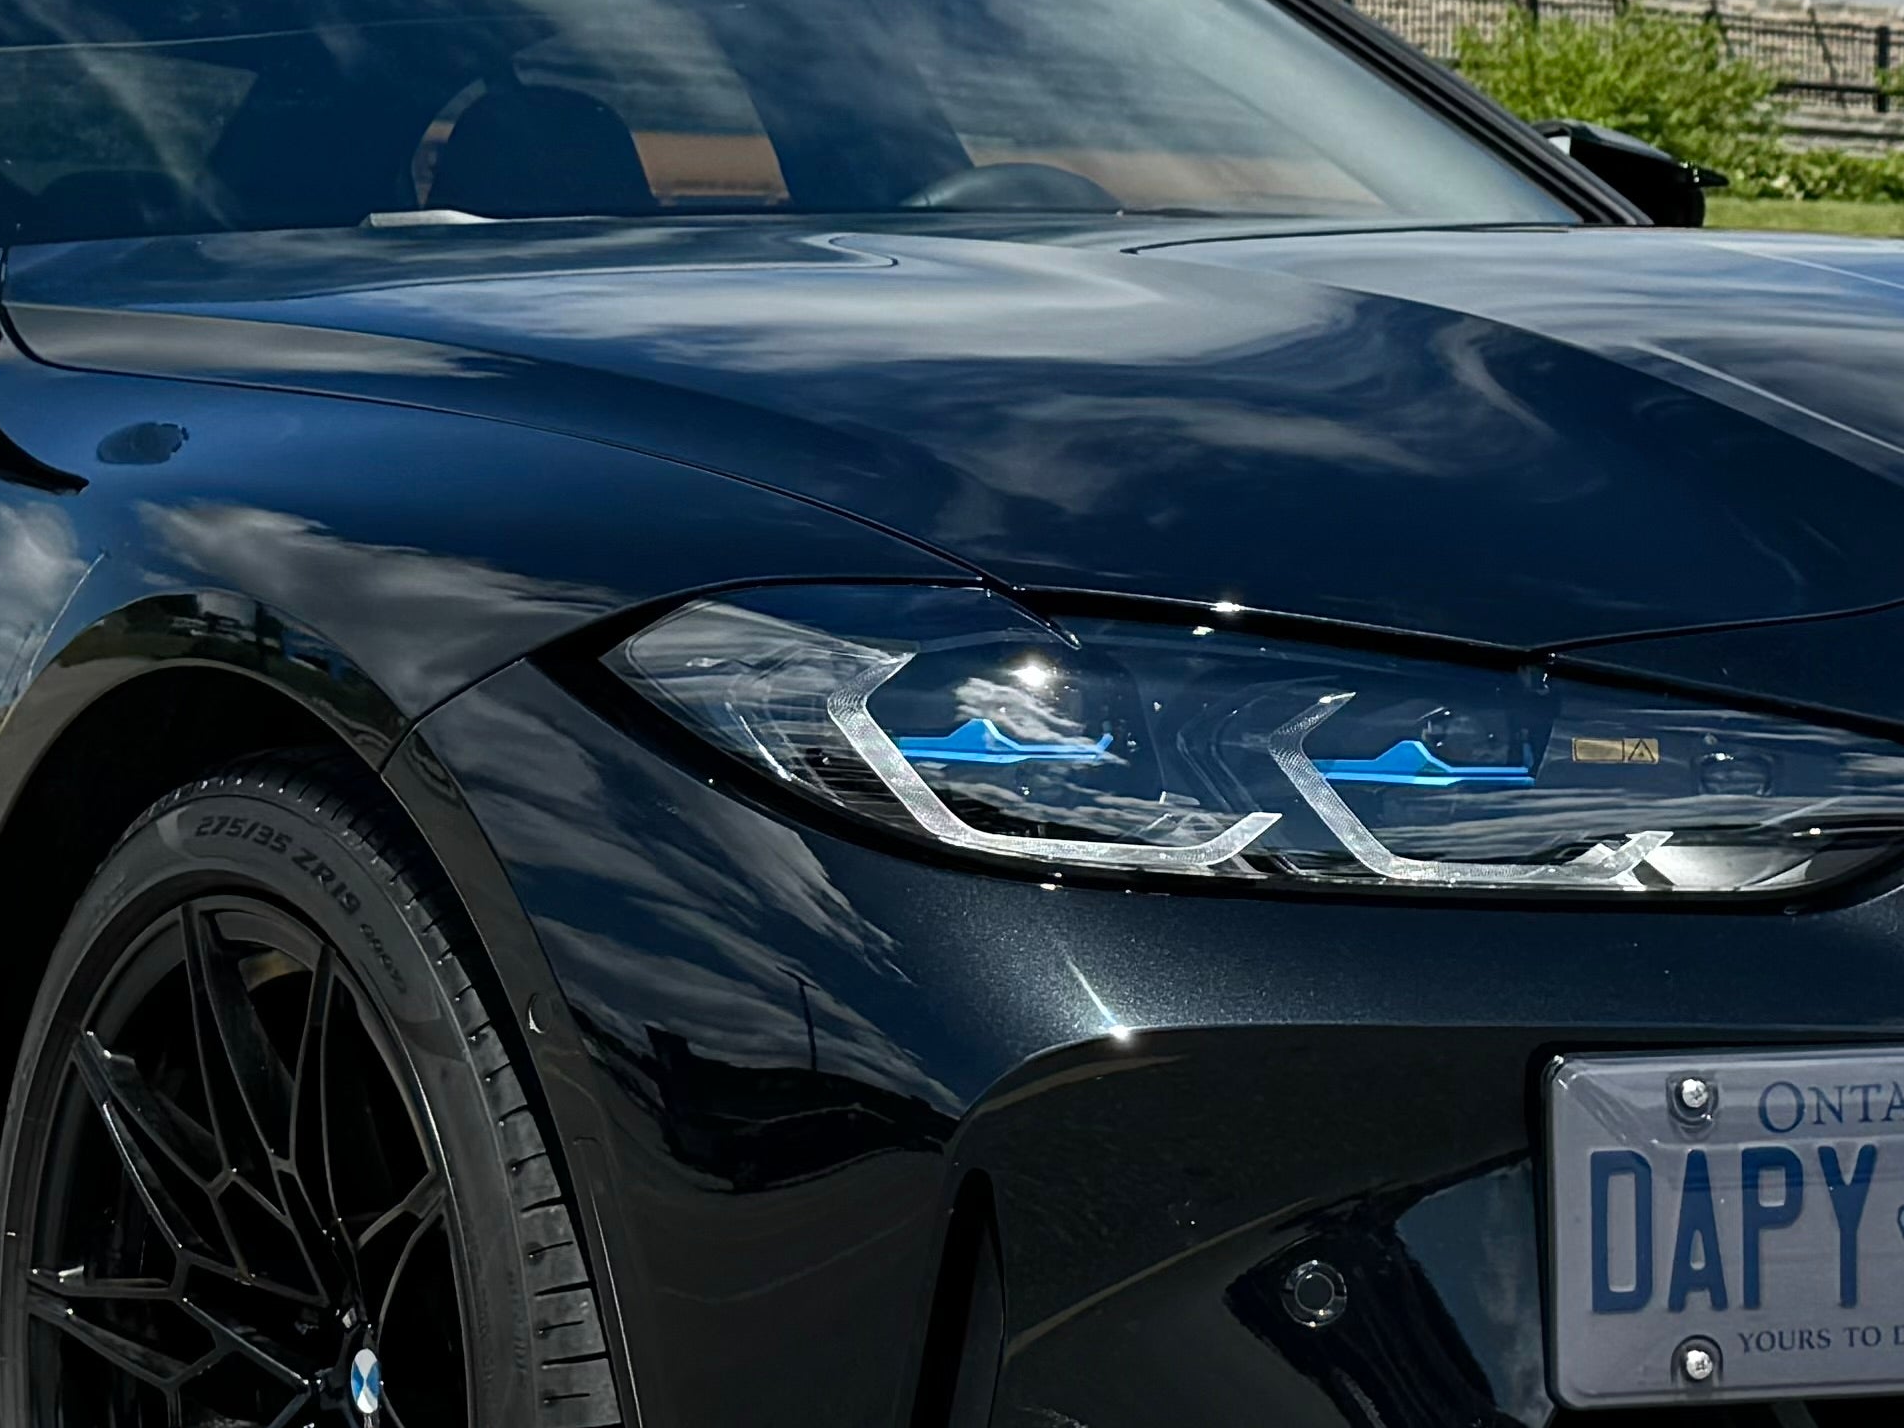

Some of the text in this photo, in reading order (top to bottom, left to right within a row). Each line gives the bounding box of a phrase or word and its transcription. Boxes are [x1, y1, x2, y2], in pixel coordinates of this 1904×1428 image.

[196, 816, 293, 853] 275/35
[1591, 1145, 1877, 1313] DAPY
[1738, 1327, 1831, 1355] YOURS
[1846, 1326, 1881, 1348] TO
